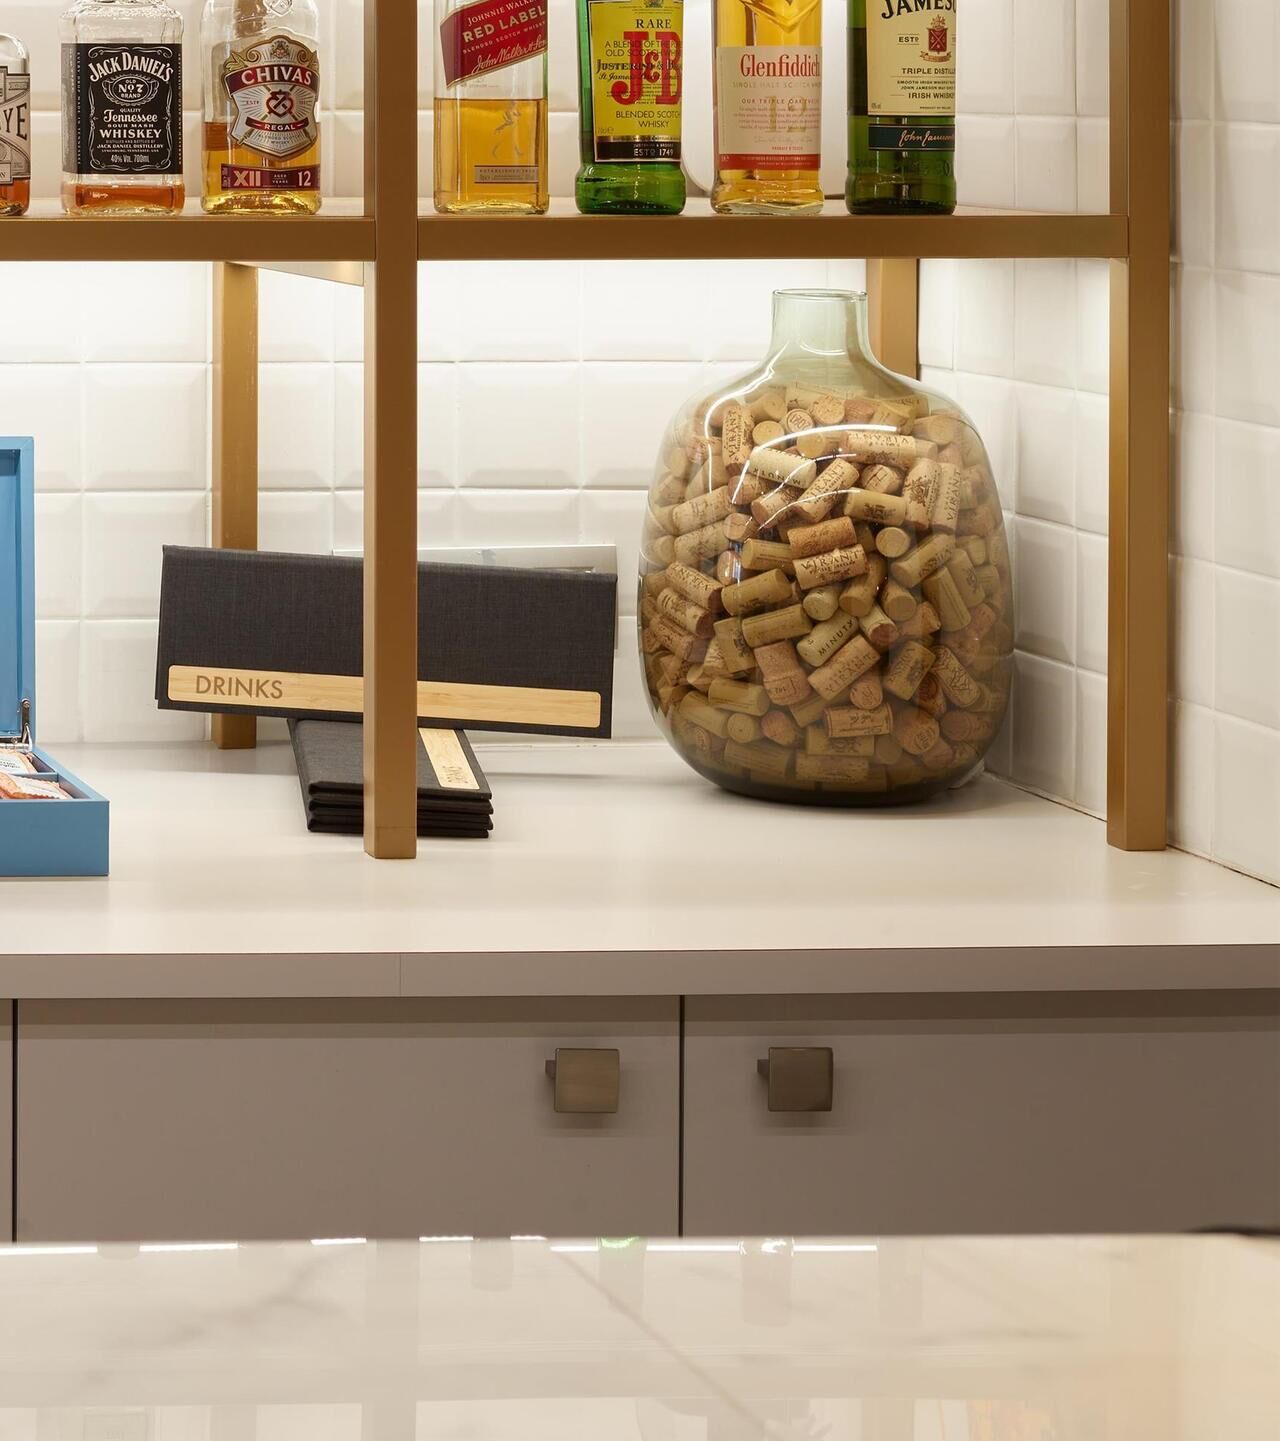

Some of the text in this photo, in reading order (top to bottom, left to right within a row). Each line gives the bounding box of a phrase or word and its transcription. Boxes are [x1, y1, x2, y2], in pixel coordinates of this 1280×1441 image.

[462, 4, 546, 43] RED LABEL
[635, 18, 672, 30] RARE
[87, 51, 174, 83] JACK DANIEL'S
[740, 54, 820, 78] Glenfiddich
[901, 68, 932, 76] TRIPLE
[240, 65, 312, 86] CHIVAS
[907, 92, 931, 100] IRISH
[102, 108, 159, 123] Tennessee
[615, 110, 682, 119] BLENDED SCOTC
[263, 123, 297, 131] REGAL
[638, 120, 670, 130] WHISKY
[99, 128, 163, 139] WHISKEY
[658, 148, 673, 158] 1749
[232, 170, 312, 187] XII 12
[195, 675, 284, 700] DRINKS
